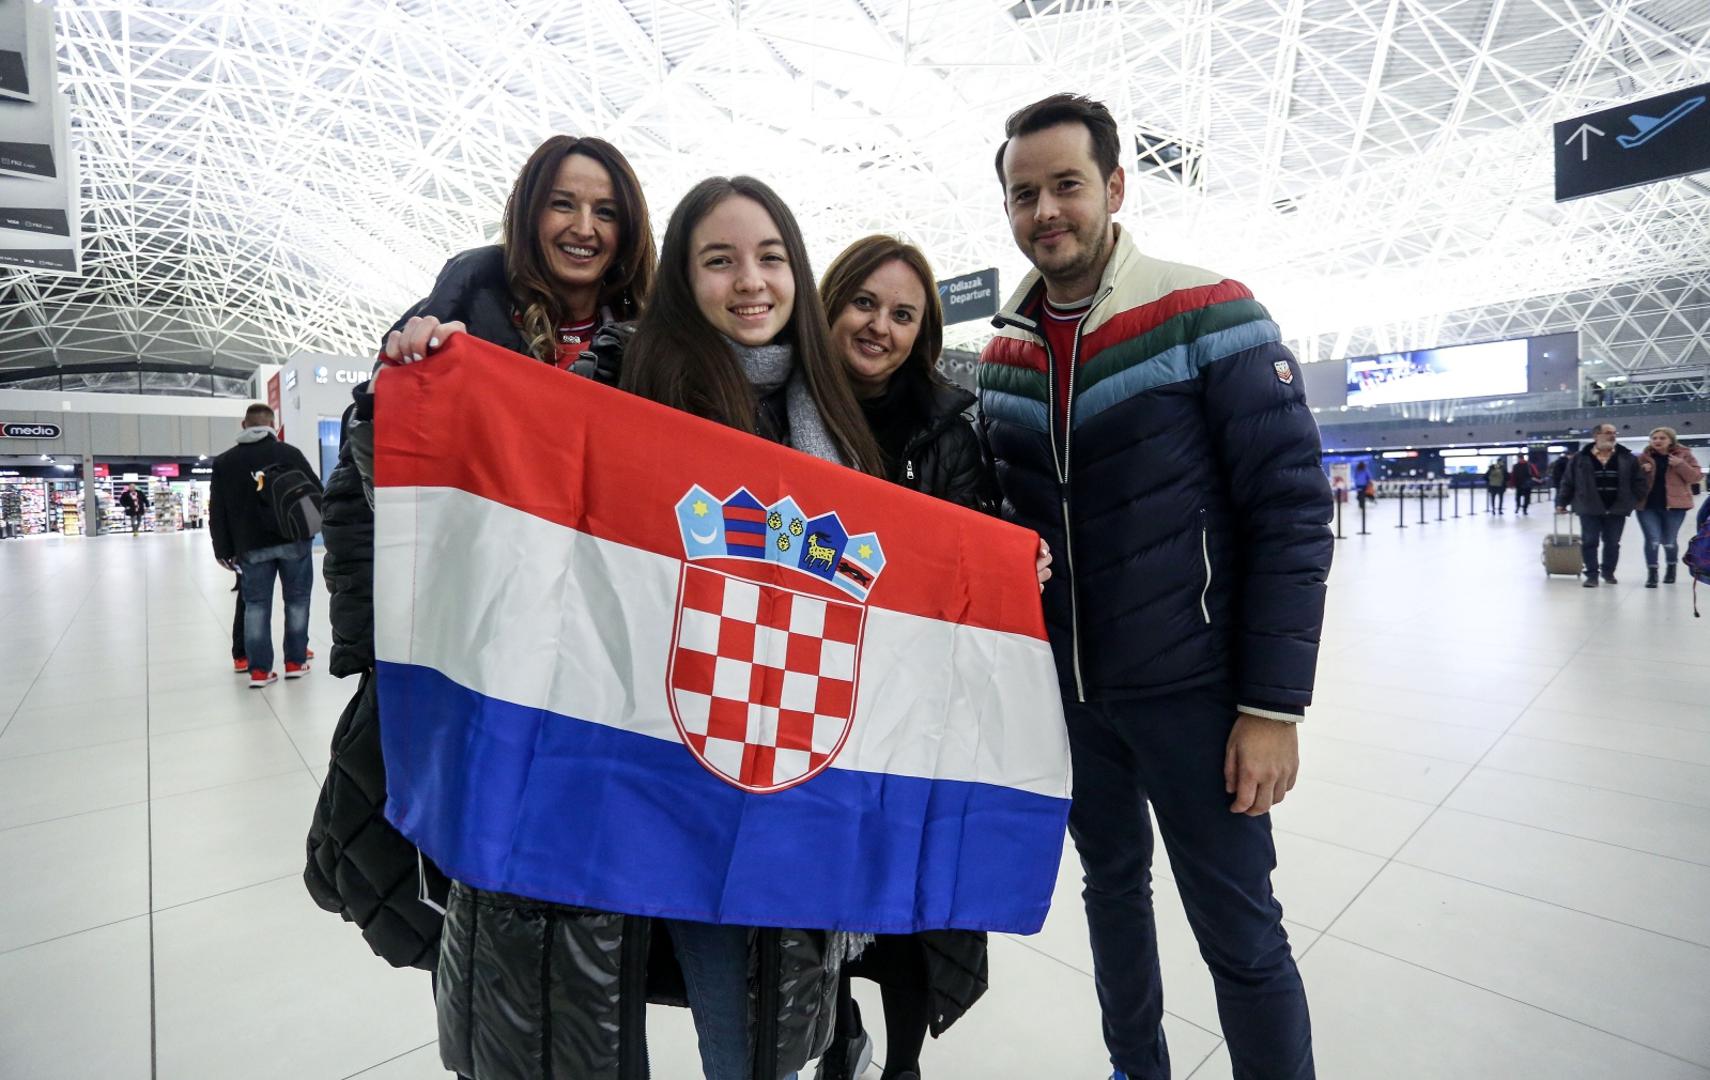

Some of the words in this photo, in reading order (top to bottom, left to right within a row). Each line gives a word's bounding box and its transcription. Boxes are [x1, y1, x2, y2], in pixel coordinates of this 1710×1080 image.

[950, 277, 983, 293] Odlazak
[950, 289, 991, 305] Departure
[10, 425, 54, 435] media
